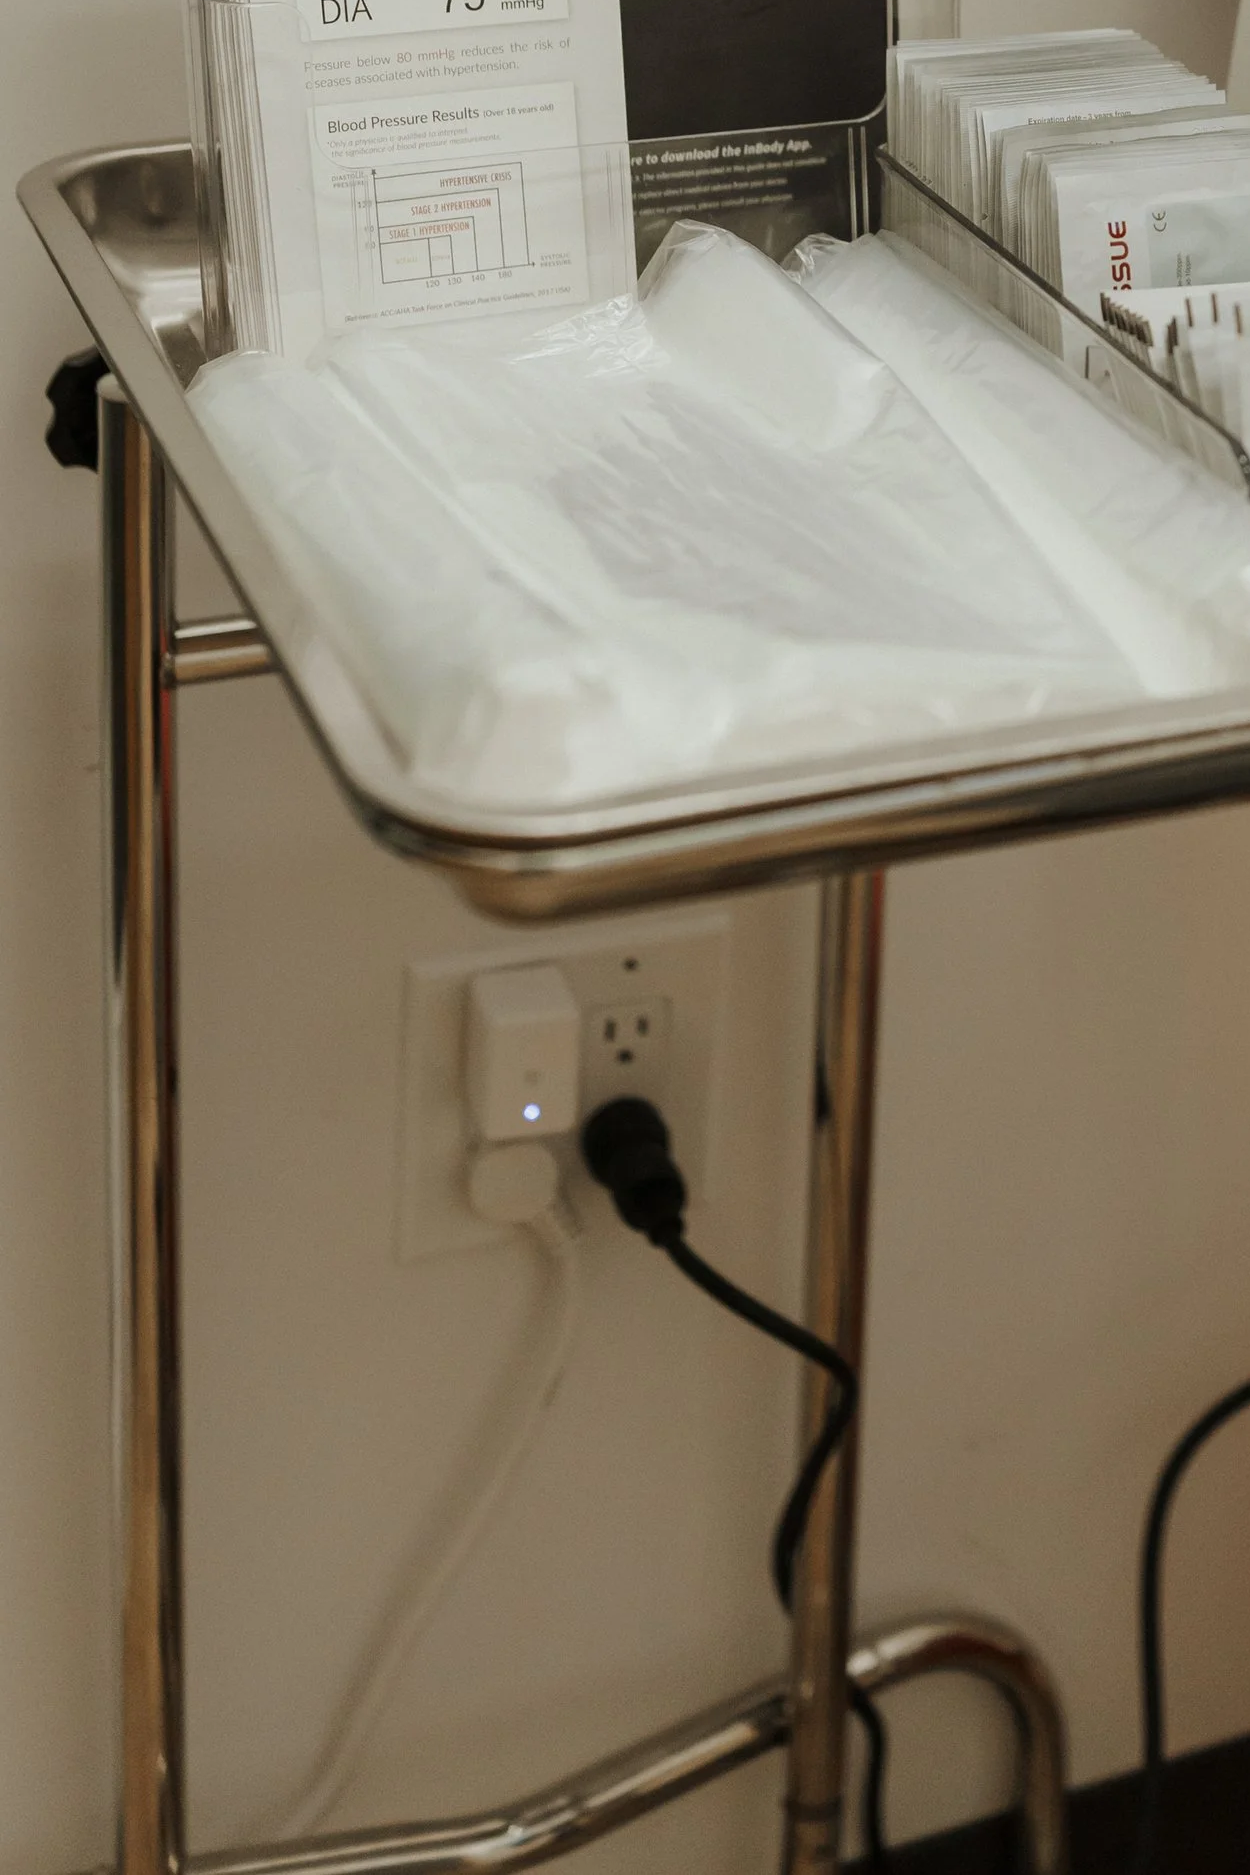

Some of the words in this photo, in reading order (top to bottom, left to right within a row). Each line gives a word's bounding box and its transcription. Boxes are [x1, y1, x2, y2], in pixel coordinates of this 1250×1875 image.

[356, 54, 391, 68] below
[396, 51, 412, 64] 80
[417, 47, 455, 62] mmHg
[460, 43, 504, 58] reduces
[510, 41, 529, 54] the
[533, 39, 554, 51] risk
[559, 37, 571, 49] of
[305, 75, 351, 90] dseases
[354, 69, 413, 85] associated
[415, 67, 440, 79] with
[327, 118, 367, 134] Blood
[371, 112, 428, 129] Pressure
[432, 107, 479, 123] Results
[483, 109, 504, 118] (Over
[518, 105, 538, 115] years
[540, 103, 554, 113] old)
[1028, 116, 1066, 125] Expiration
[1066, 114, 1083, 122] date
[646, 153, 658, 165] to
[661, 147, 719, 163] download
[722, 144, 741, 158] the
[744, 141, 785, 156] InBody
[440, 174, 489, 188] HYPERTENSIVE
[490, 171, 512, 183] CRISIS
[411, 204, 432, 216] STAGE
[434, 203, 439, 213] 2
[440, 197, 491, 212] HYPERTENSION
[389, 228, 411, 240] STAGE
[412, 227, 417, 237] 1
[419, 222, 470, 236] HYPERTENSION
[425, 279, 440, 289] 120
[447, 276, 462, 286] 130
[471, 273, 486, 283] 140
